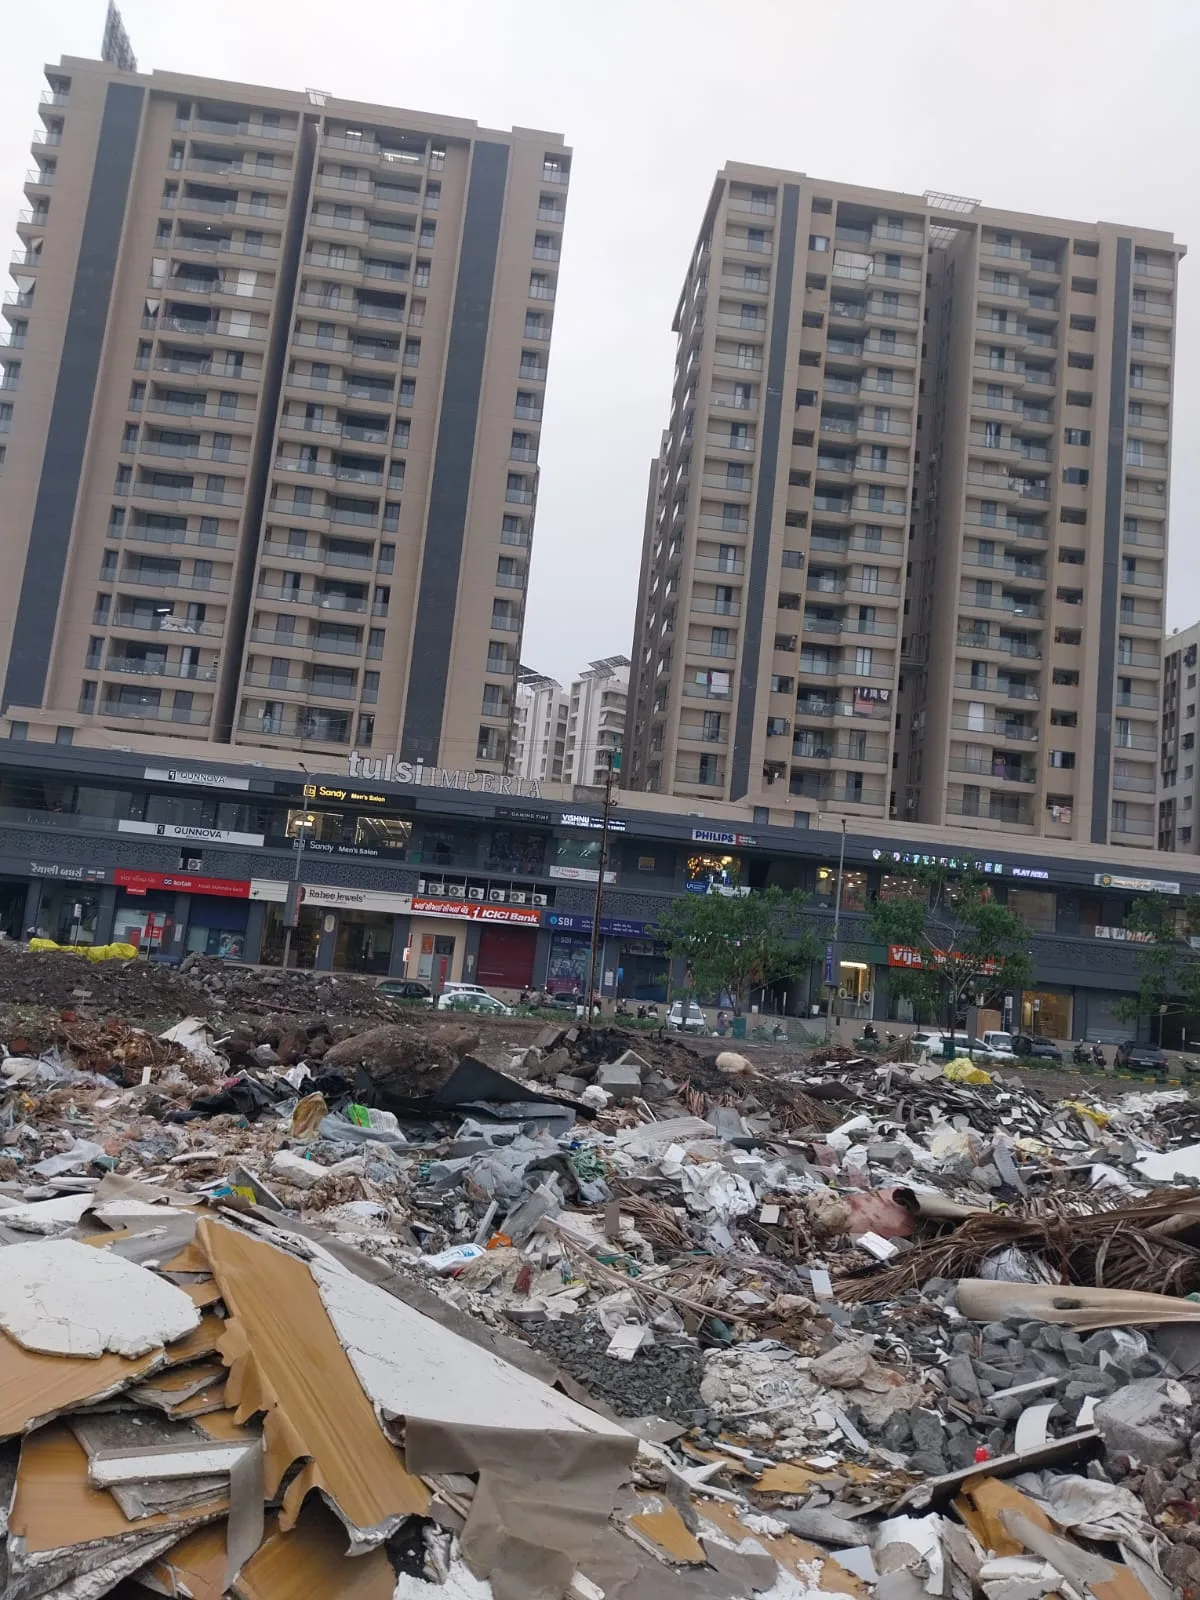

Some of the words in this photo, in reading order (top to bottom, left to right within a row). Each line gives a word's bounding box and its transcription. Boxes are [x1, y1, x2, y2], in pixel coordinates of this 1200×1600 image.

[180, 771, 225, 783] QUNNOVA
[348, 750, 424, 784] tulsi
[429, 767, 541, 798] IMPERIA
[319, 786, 346, 800] Sandy
[562, 813, 590, 823] VISHNU
[174, 826, 222, 838] QUNNOVA
[695, 830, 734, 842] PHILIPS
[310, 841, 334, 852] Sandy
[359, 848, 378, 856] Salon
[481, 909, 509, 919] ICICI
[510, 913, 539, 923] Bank
[558, 916, 573, 927] SBI
